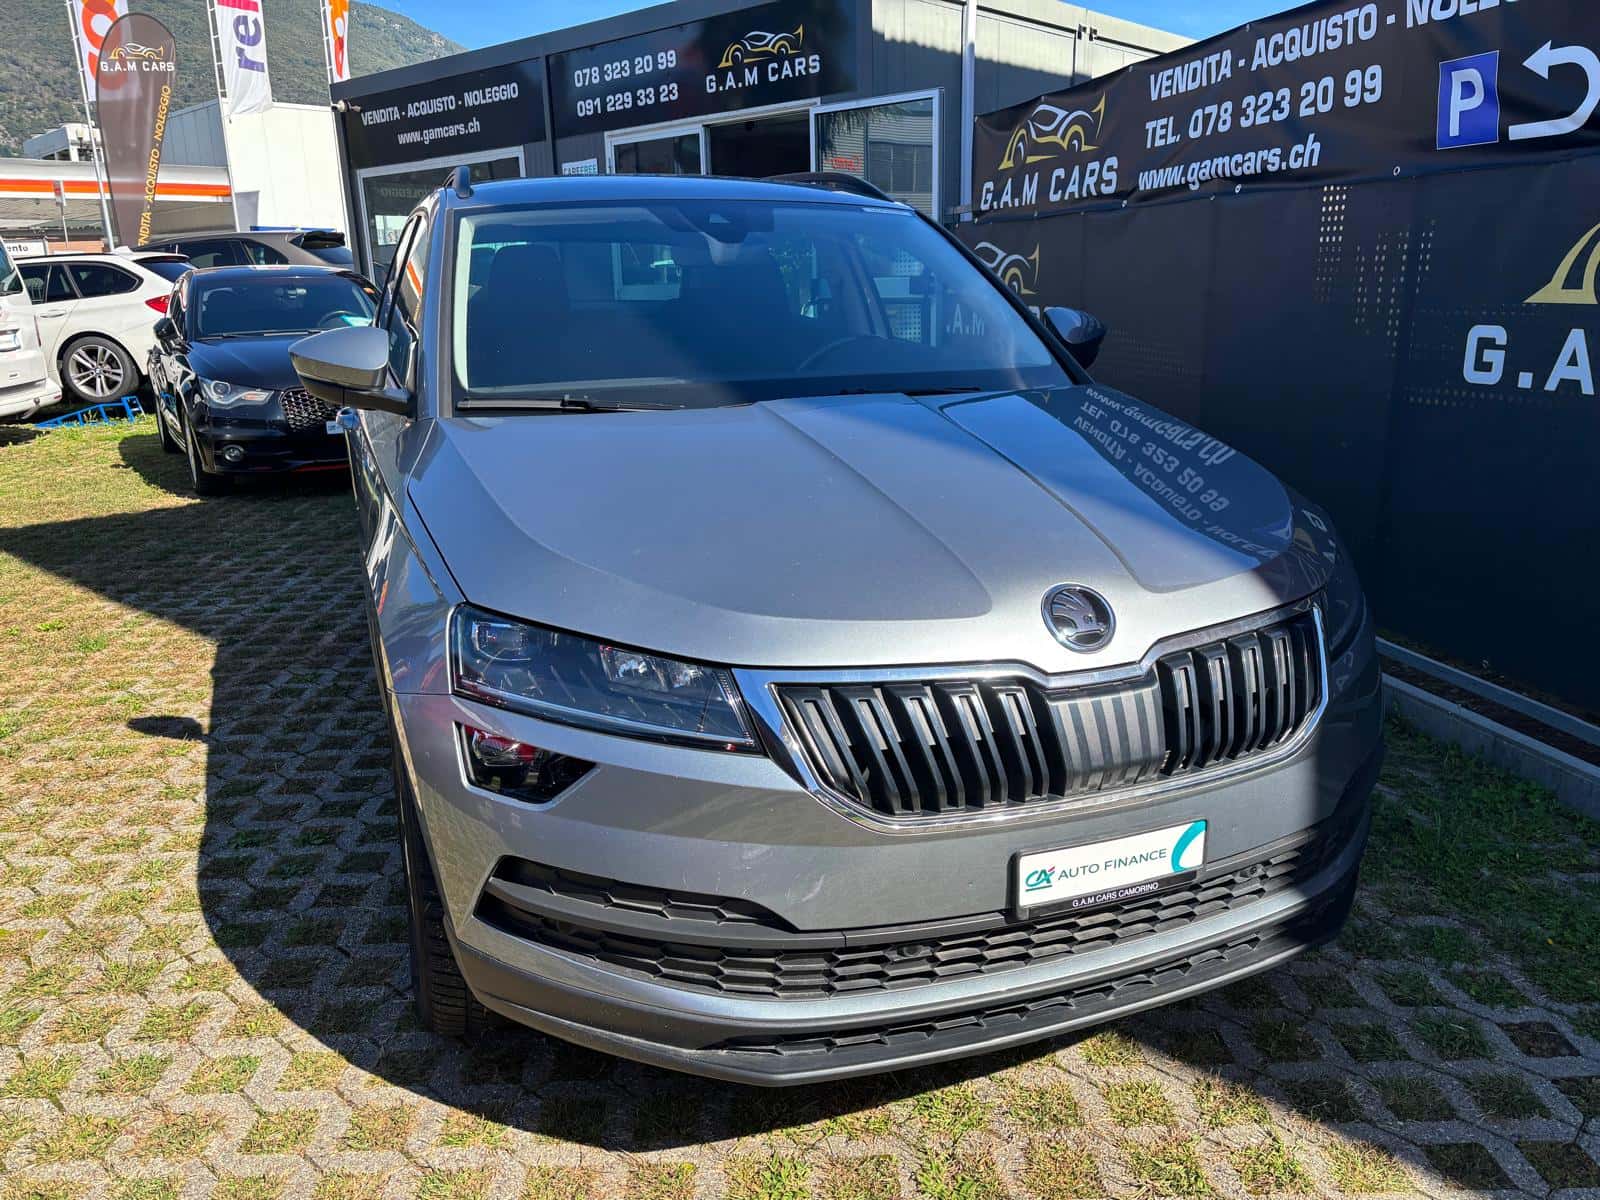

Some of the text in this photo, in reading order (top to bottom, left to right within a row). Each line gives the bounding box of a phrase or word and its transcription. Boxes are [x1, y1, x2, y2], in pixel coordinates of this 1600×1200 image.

[100, 61, 175, 72] G.A.M CARS
[574, 49, 677, 87] 078 323 20 99
[1149, 49, 1232, 101] VENDITA
[1250, 3, 1378, 71] ACQUISTO
[706, 54, 821, 93] G.A.M CARS
[361, 106, 401, 126] VENDITA
[407, 95, 456, 118] ACQUISTO
[464, 82, 519, 107] NOLEGGIO
[577, 82, 679, 117] 091 229 33 23
[1145, 64, 1383, 149] TEL. 078 323 20 99
[1449, 67, 1485, 137] P
[144, 148, 160, 203] ACQUISTO
[153, 85, 171, 142] NOLEGGIO
[397, 116, 481, 145] www.gamcars.ch
[1138, 132, 1321, 191] www.gamcars.ch
[980, 156, 1119, 211] G.A.M CARS
[1058, 863, 1100, 880] AUTO
[1104, 848, 1168, 871] FINANCE
[1072, 881, 1159, 908] G.A.M CARS CAMORINO
